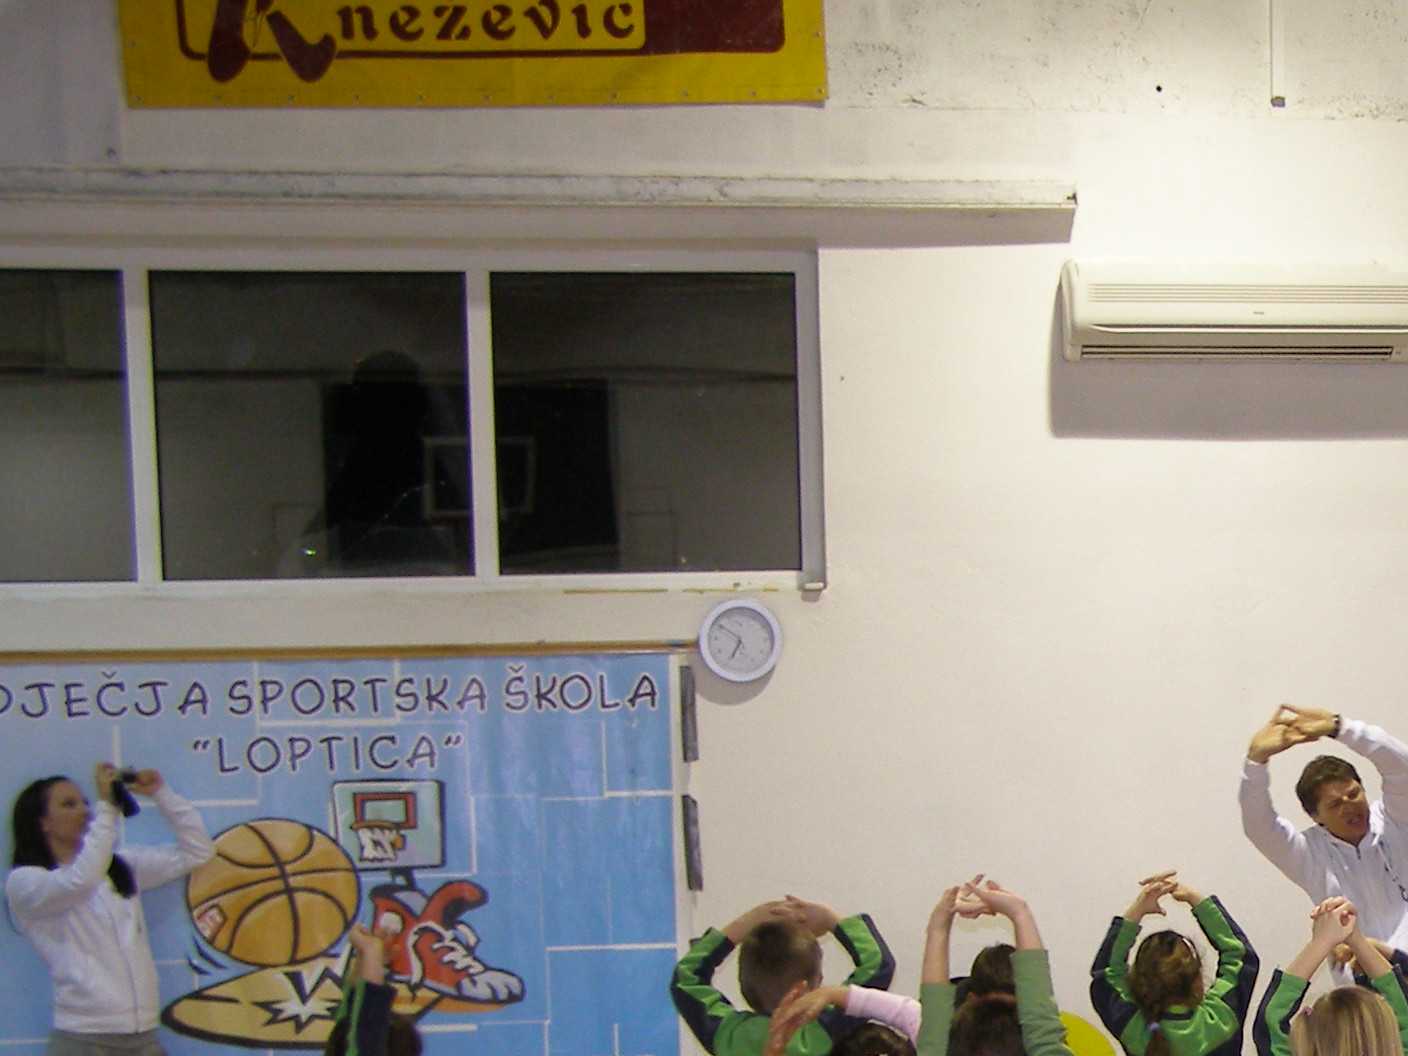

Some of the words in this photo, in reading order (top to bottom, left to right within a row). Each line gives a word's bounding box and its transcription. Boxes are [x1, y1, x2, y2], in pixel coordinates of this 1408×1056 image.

[227, 676, 487, 716] SPORTSKA
[504, 665, 657, 711] ŠKOLA
[192, 735, 462, 774] "LOPTICA"
